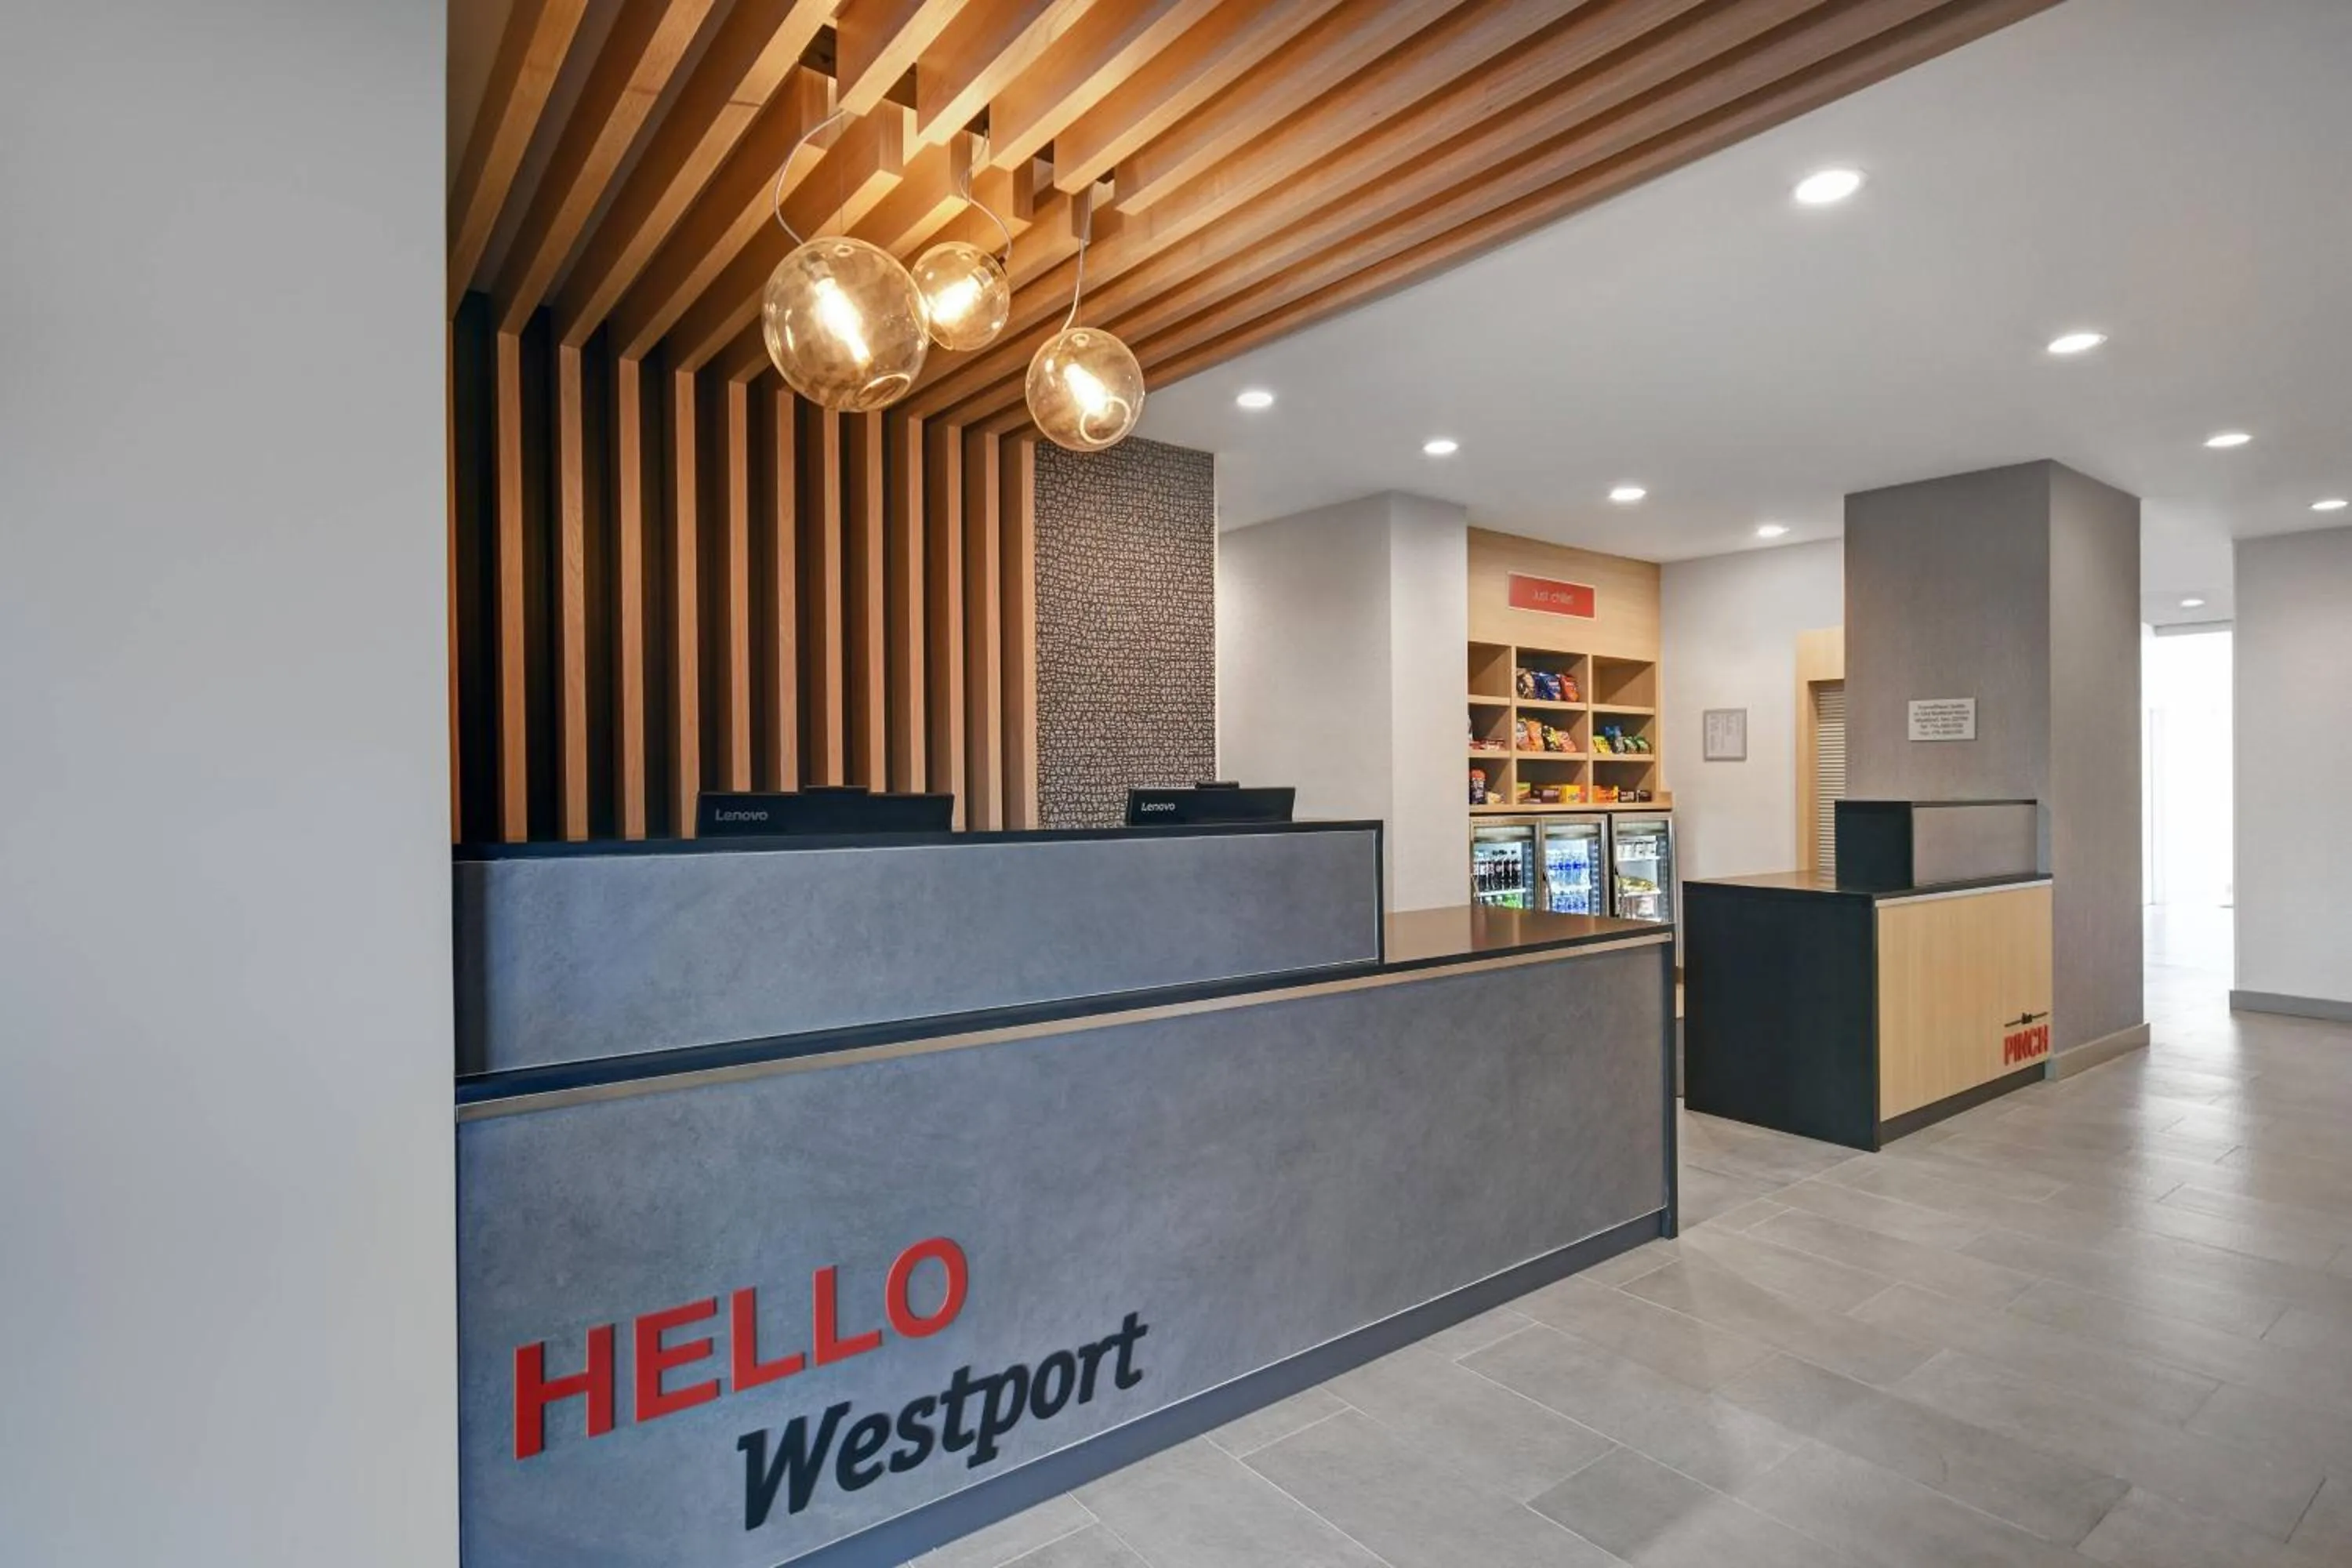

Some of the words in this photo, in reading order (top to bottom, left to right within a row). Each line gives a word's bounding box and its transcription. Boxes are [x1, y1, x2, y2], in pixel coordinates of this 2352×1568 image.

[715, 808, 768, 821] Lenovo
[1142, 802, 1175, 811] Lenovo
[2004, 1023, 2048, 1066] PINCH
[514, 1236, 969, 1461] HELLO
[736, 1311, 1149, 1531] Westport
